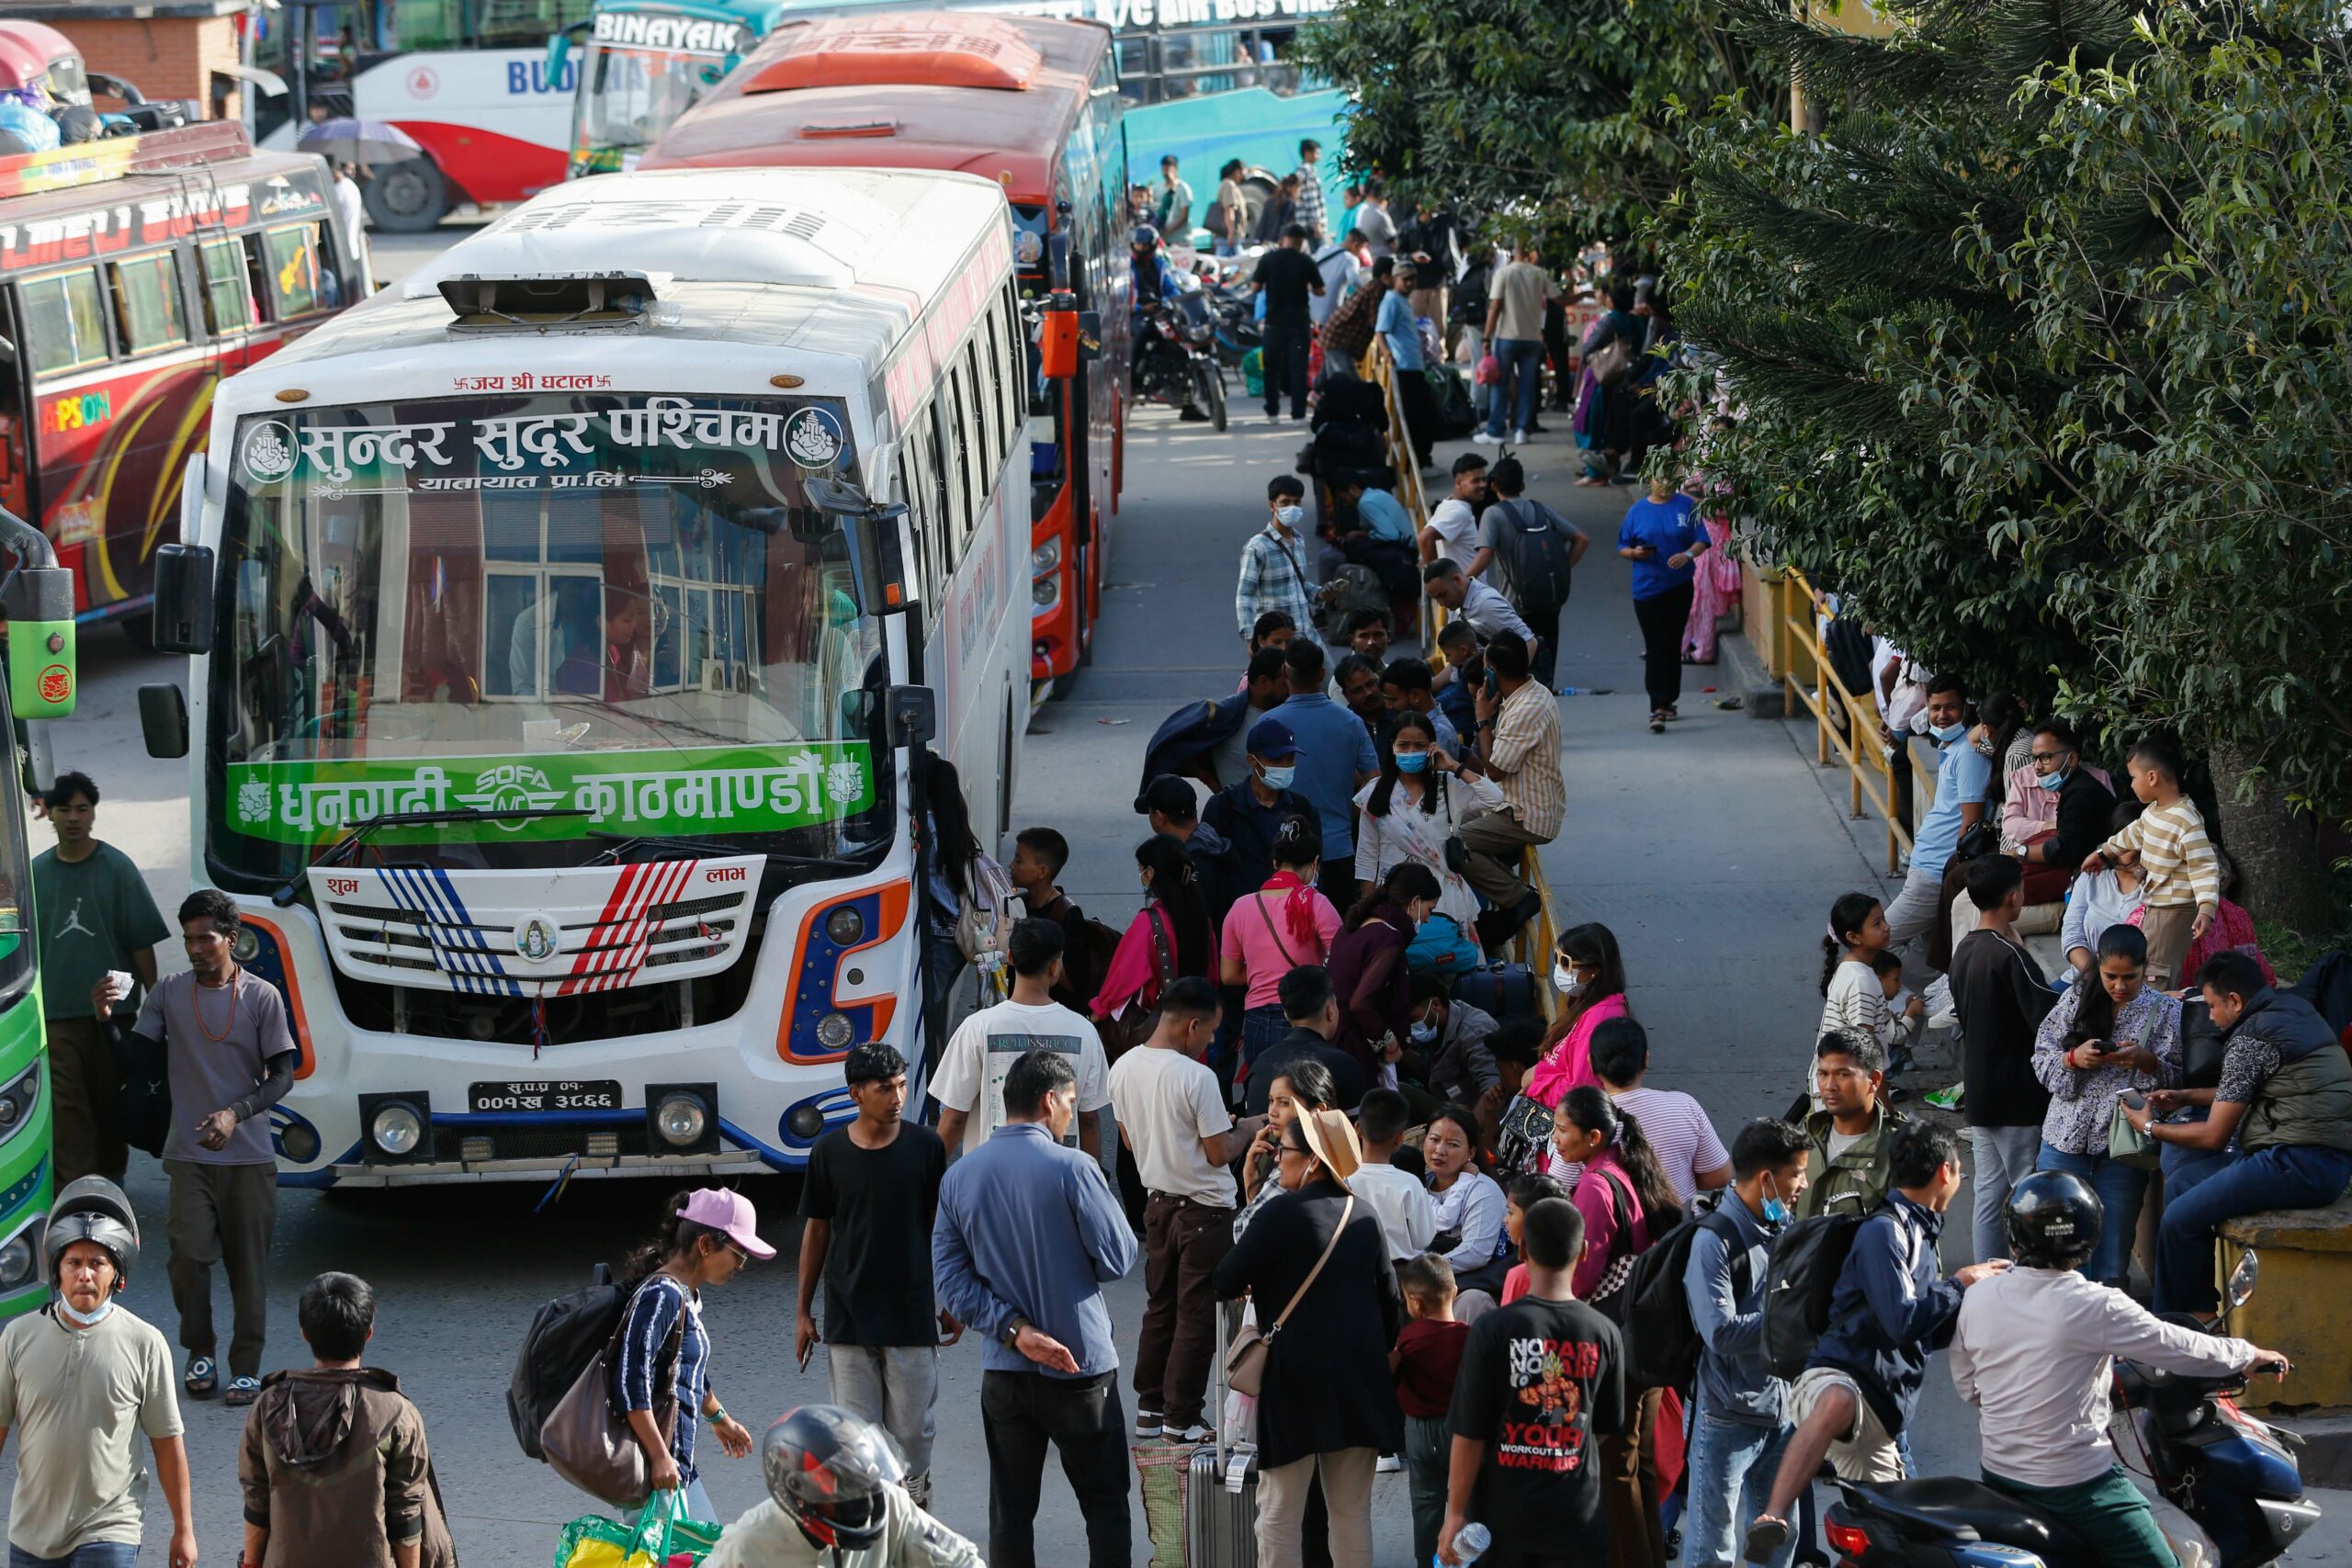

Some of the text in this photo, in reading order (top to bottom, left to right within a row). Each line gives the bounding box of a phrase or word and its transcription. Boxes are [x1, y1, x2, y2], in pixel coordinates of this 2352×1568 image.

[596, 12, 740, 51] BINAYAK
[470, 371, 594, 390] जय श्री घटाल
[44, 389, 111, 434] APSON
[300, 396, 784, 482] सुन्दर सुदूर पश्चिम
[418, 475, 539, 491] यातायात
[476, 764, 552, 794] SOFA
[706, 867, 746, 883] लाभ
[327, 879, 359, 896] शुभ
[1510, 1338, 1600, 1359] NO PAIN
[1510, 1357, 1543, 1374] NO
[1505, 1423, 1582, 1449] YOUR
[1500, 1444, 1553, 1456] WORKOUT
